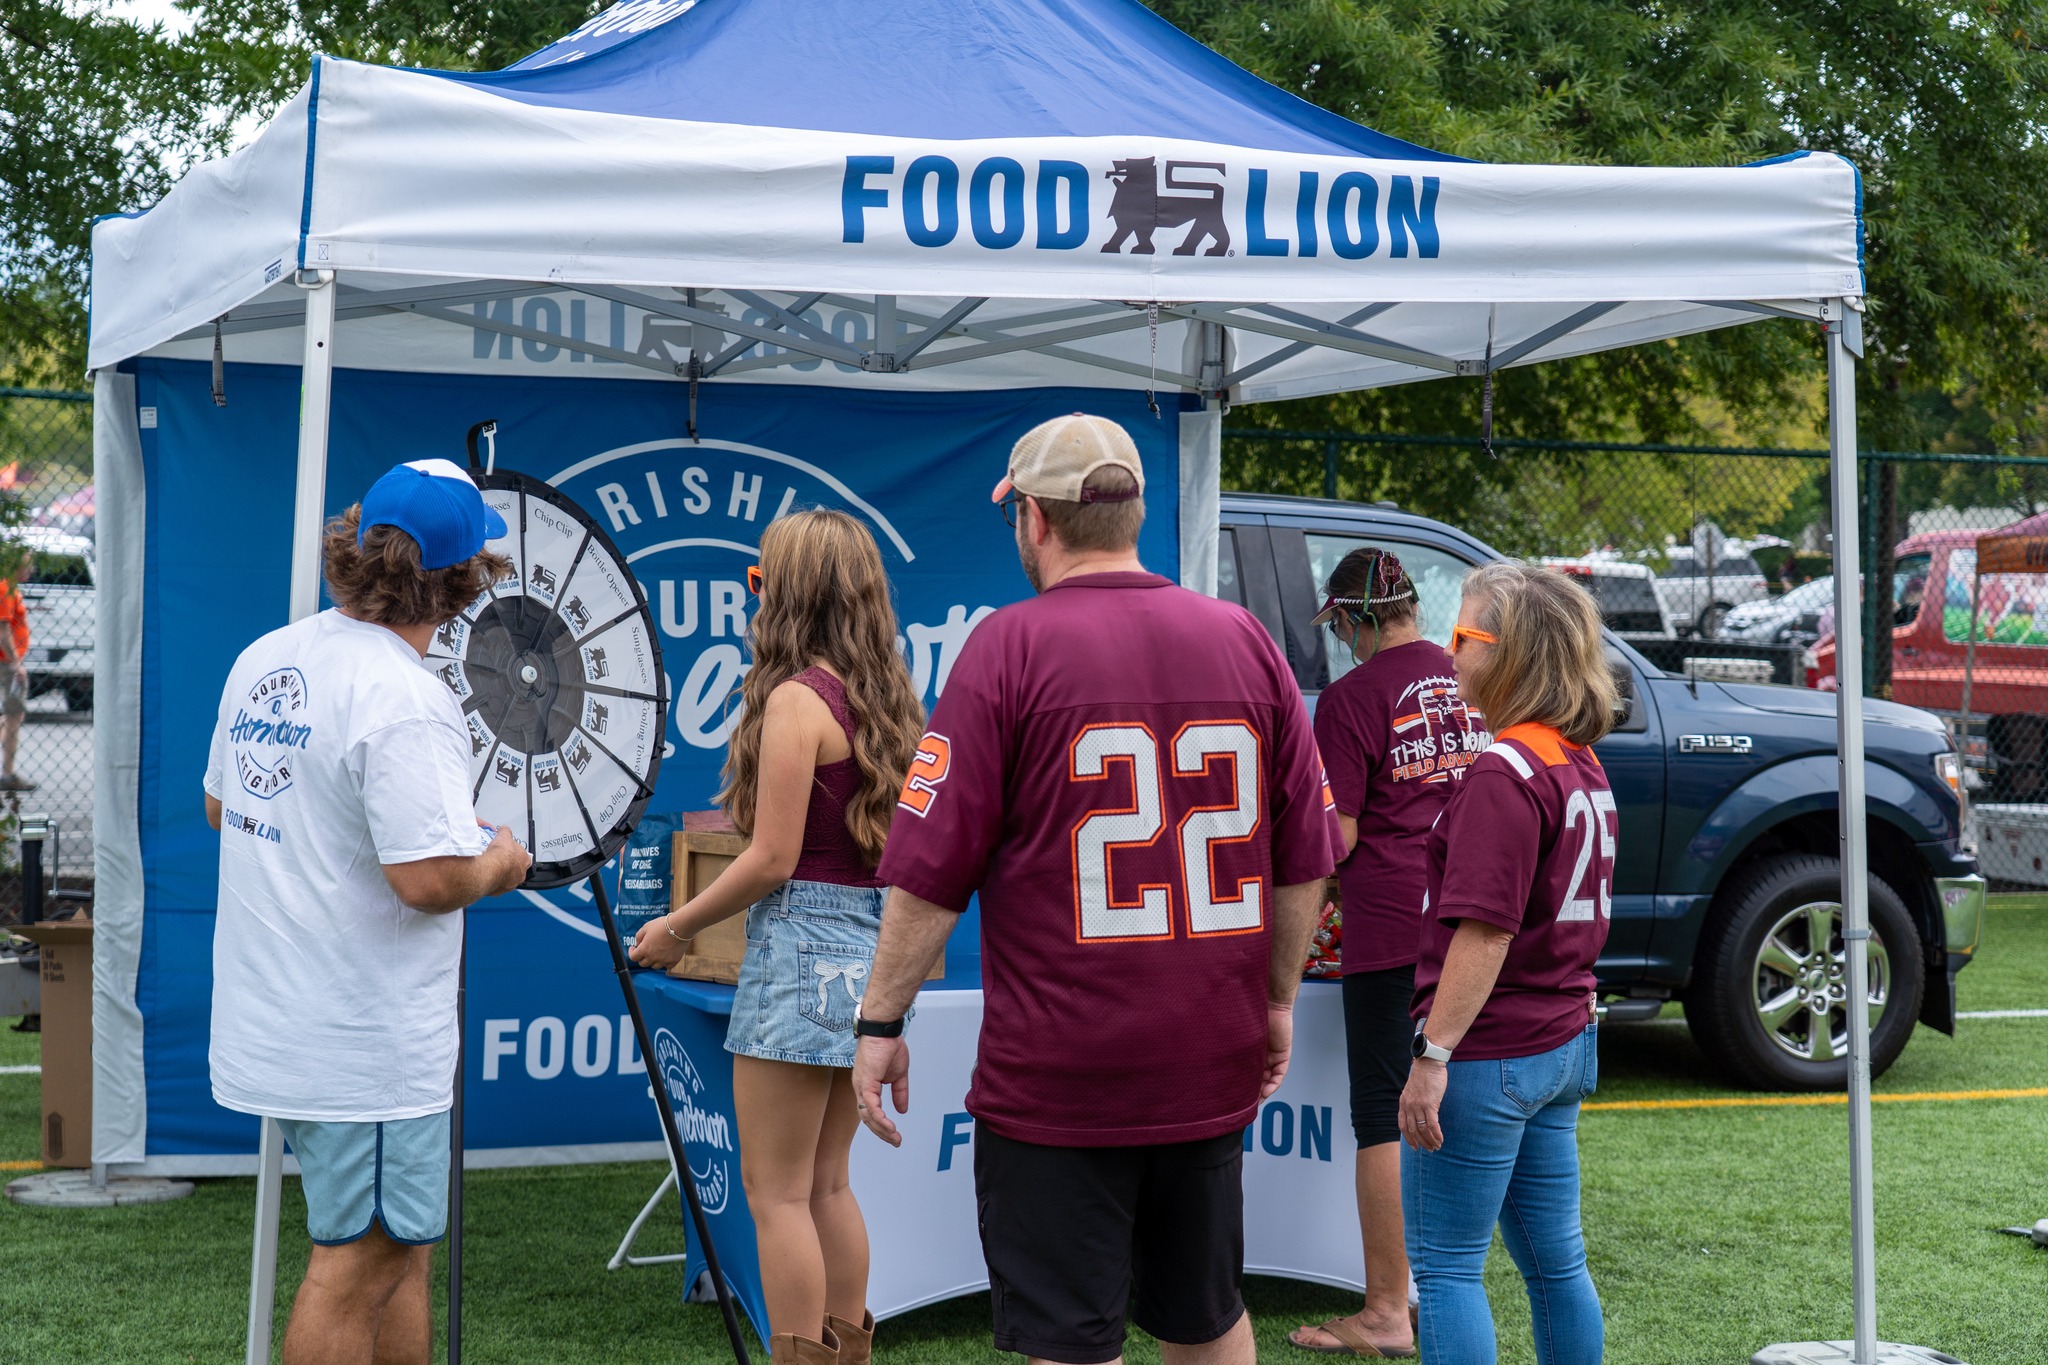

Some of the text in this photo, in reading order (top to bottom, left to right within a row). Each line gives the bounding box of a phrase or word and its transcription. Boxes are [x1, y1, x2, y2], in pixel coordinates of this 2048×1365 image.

[841, 154, 1441, 259] FOOD LION
[534, 508, 573, 538] Chip Clip
[495, 580, 520, 590] FOOD LION
[587, 544, 630, 607] Bottle Opener
[529, 583, 554, 602] FOOD LION
[561, 607, 581, 636] FOOD LION
[454, 623, 466, 656] FOOD LION
[631, 626, 648, 684] Sunglasses
[453, 662, 467, 696] FOOD LION
[1442, 706, 1453, 716] 25
[470, 716, 492, 746] FOOD LION
[564, 733, 581, 758] FOOD LION
[634, 700, 651, 776] Cooling Towel
[499, 750, 524, 767] FOOD LION
[534, 759, 558, 769] FOOD LION
[1390, 736, 1437, 767] THIS
[1441, 732, 1458, 754] IS
[1392, 758, 1435, 783] FIELD
[1450, 767, 1467, 780] VT
[599, 785, 628, 823] Chip Clip
[225, 808, 281, 844] FOOD LION
[541, 832, 583, 850] Sunglasses
[1070, 718, 1264, 944] 22
[1555, 788, 1618, 923] 25
